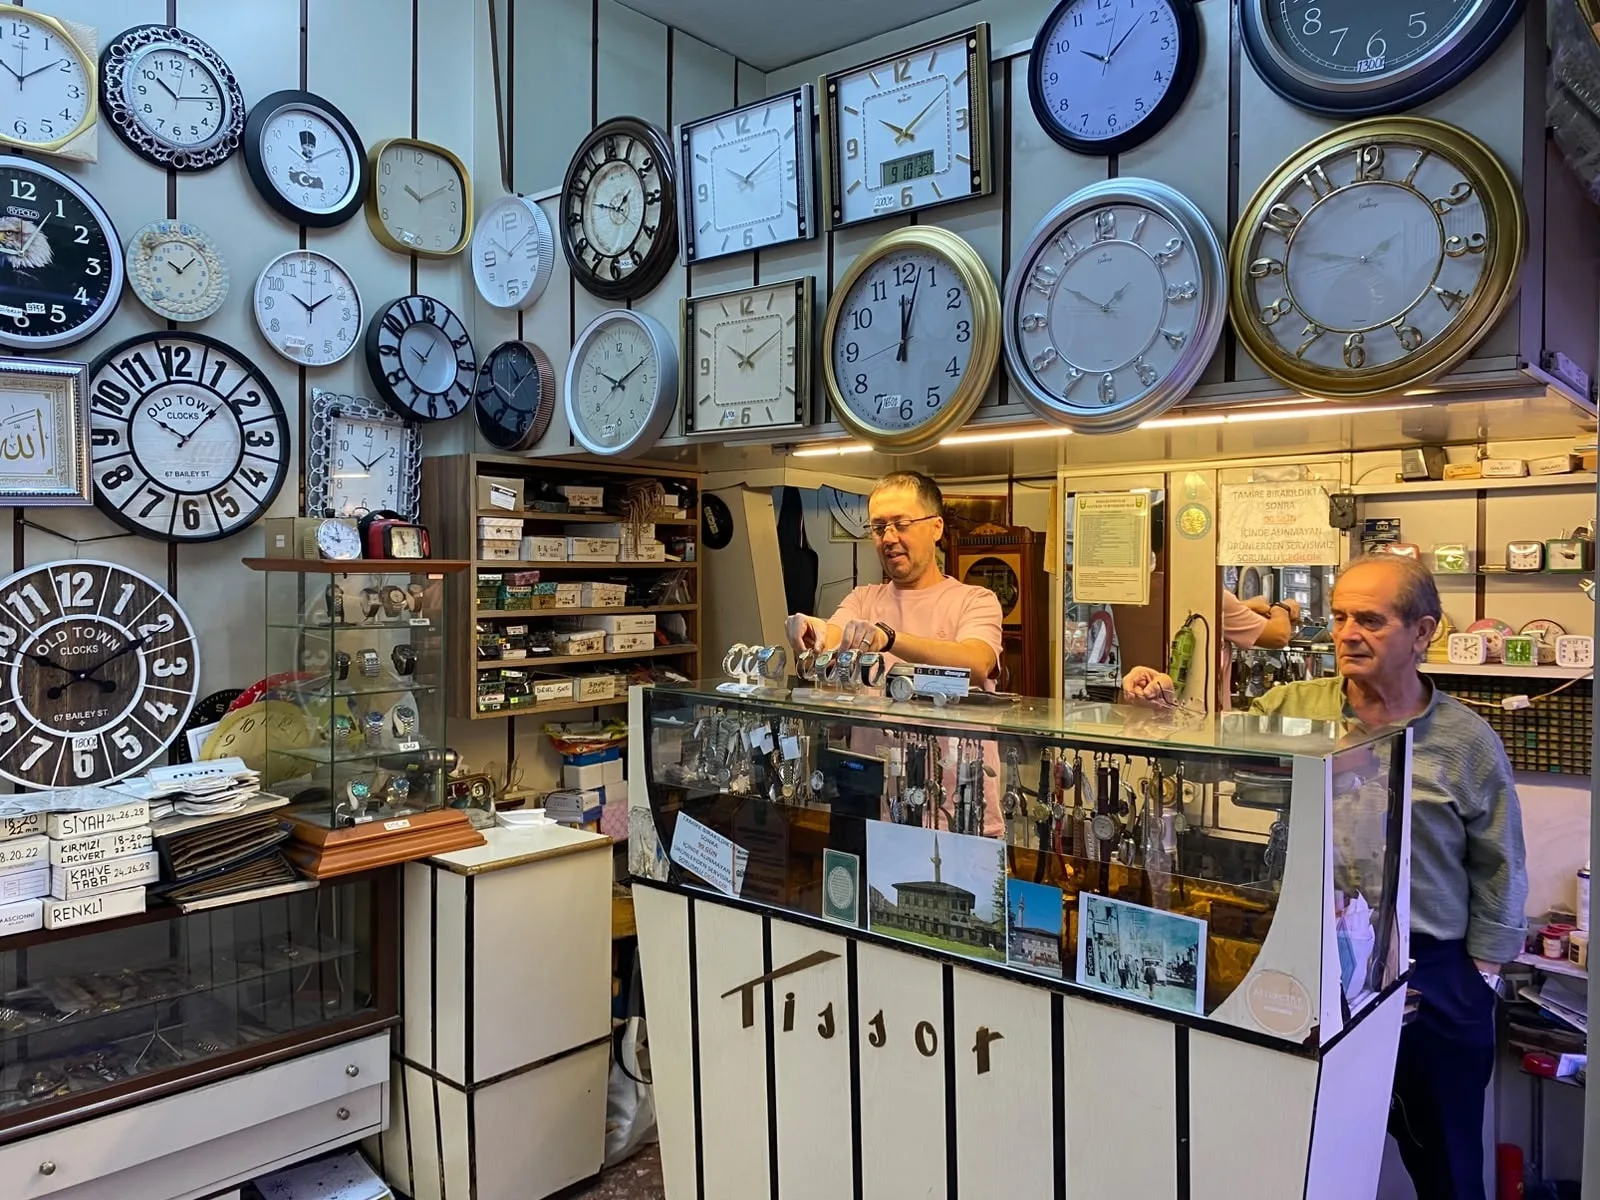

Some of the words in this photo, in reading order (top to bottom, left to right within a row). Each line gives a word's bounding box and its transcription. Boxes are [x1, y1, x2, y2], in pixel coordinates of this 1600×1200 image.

[1073, 13, 1083, 27] 11
[1150, 11, 1159, 24] 2
[1302, 7, 1322, 36] 8
[1407, 11, 1427, 39] 5
[12, 23, 30, 39] 12
[1329, 27, 1349, 56] 7
[1056, 40, 1070, 54] 10
[1161, 37, 1170, 50] 3
[1366, 29, 1387, 58] 6
[60, 59, 71, 73] 2
[142, 69, 155, 80] 10
[169, 59, 182, 71] 12
[894, 58, 912, 83] 12
[1050, 72, 1058, 85] 9
[1153, 70, 1163, 83] 4
[67, 84, 79, 99] 3
[59, 108, 72, 120] 4
[1060, 98, 1069, 111] 8
[1135, 98, 1144, 111] 5
[14, 120, 27, 135] 6
[40, 119, 53, 133] 5
[735, 113, 750, 136] 12
[956, 108, 968, 131] 3
[1081, 114, 1089, 127] 7
[1108, 113, 1117, 127] 6
[414, 152, 424, 165] 12
[847, 138, 858, 160] 9
[1351, 145, 1385, 184] 12
[10, 179, 37, 201] 12
[698, 183, 708, 203] 9
[1298, 165, 1341, 205] 11
[901, 186, 913, 207] 6
[1431, 182, 1474, 216] 2
[55, 200, 66, 218] 1
[1094, 209, 1116, 243] 12
[1262, 202, 1300, 244] 10
[74, 225, 90, 244] 2
[743, 228, 753, 247] 6
[1444, 233, 1487, 257] 3
[85, 258, 101, 275] 3
[300, 260, 317, 275] 12
[893, 262, 916, 287] 12
[928, 266, 937, 287] 1
[1249, 257, 1284, 278] 9
[268, 276, 284, 291] 10
[871, 280, 887, 301] 11
[74, 286, 90, 306] 4
[740, 296, 754, 317] 12
[946, 288, 961, 310] 2
[1431, 284, 1469, 311] 4
[50, 304, 66, 323] 5
[852, 308, 872, 330] 10
[1259, 298, 1293, 325] 8
[956, 320, 970, 342] 3
[1022, 313, 1048, 332] 9
[1390, 316, 1423, 350] 5
[1296, 323, 1326, 358] 7
[1343, 333, 1366, 368] 6
[160, 346, 192, 378] 12
[846, 342, 859, 362] 9
[120, 352, 157, 388] 11
[209, 360, 227, 388] 1
[700, 358, 710, 376] 9
[945, 356, 960, 377] 4
[854, 374, 868, 394] 8
[91, 380, 130, 416] 10
[231, 391, 261, 416] 2
[927, 386, 941, 407] 5
[147, 396, 172, 419] OLD
[167, 412, 199, 420] CLOCKS
[741, 407, 751, 425] 6
[900, 399, 913, 420] 6
[91, 428, 120, 446] 9
[246, 431, 274, 448] 3
[365, 427, 373, 438] 12
[340, 440, 349, 451] 10
[101, 465, 134, 490] 8
[239, 467, 268, 488] 4
[139, 488, 166, 518] 7
[214, 488, 240, 518] 5
[1265, 502, 1296, 510] SONRA
[182, 500, 200, 530] 6
[55, 571, 94, 607] 12
[113, 583, 136, 615] 1
[6, 583, 50, 624] 11
[138, 613, 174, 643] 2
[36, 630, 68, 656] OLD
[72, 627, 120, 651] TOWN
[60, 645, 99, 656] CLOCKS
[152, 657, 188, 677] 3
[54, 714, 64, 722] 67
[66, 711, 95, 721] BAILEY
[144, 701, 178, 723] 4
[19, 735, 54, 771] 7
[111, 726, 143, 760] 5
[73, 749, 95, 779] 6
[63, 814, 104, 835] SİYAH
[61, 840, 100, 853] KIRMIZI
[61, 850, 105, 864] LACİVERT
[70, 865, 111, 881] KAHVE
[71, 876, 108, 891] TABA
[53, 898, 103, 923] RENKLİ
